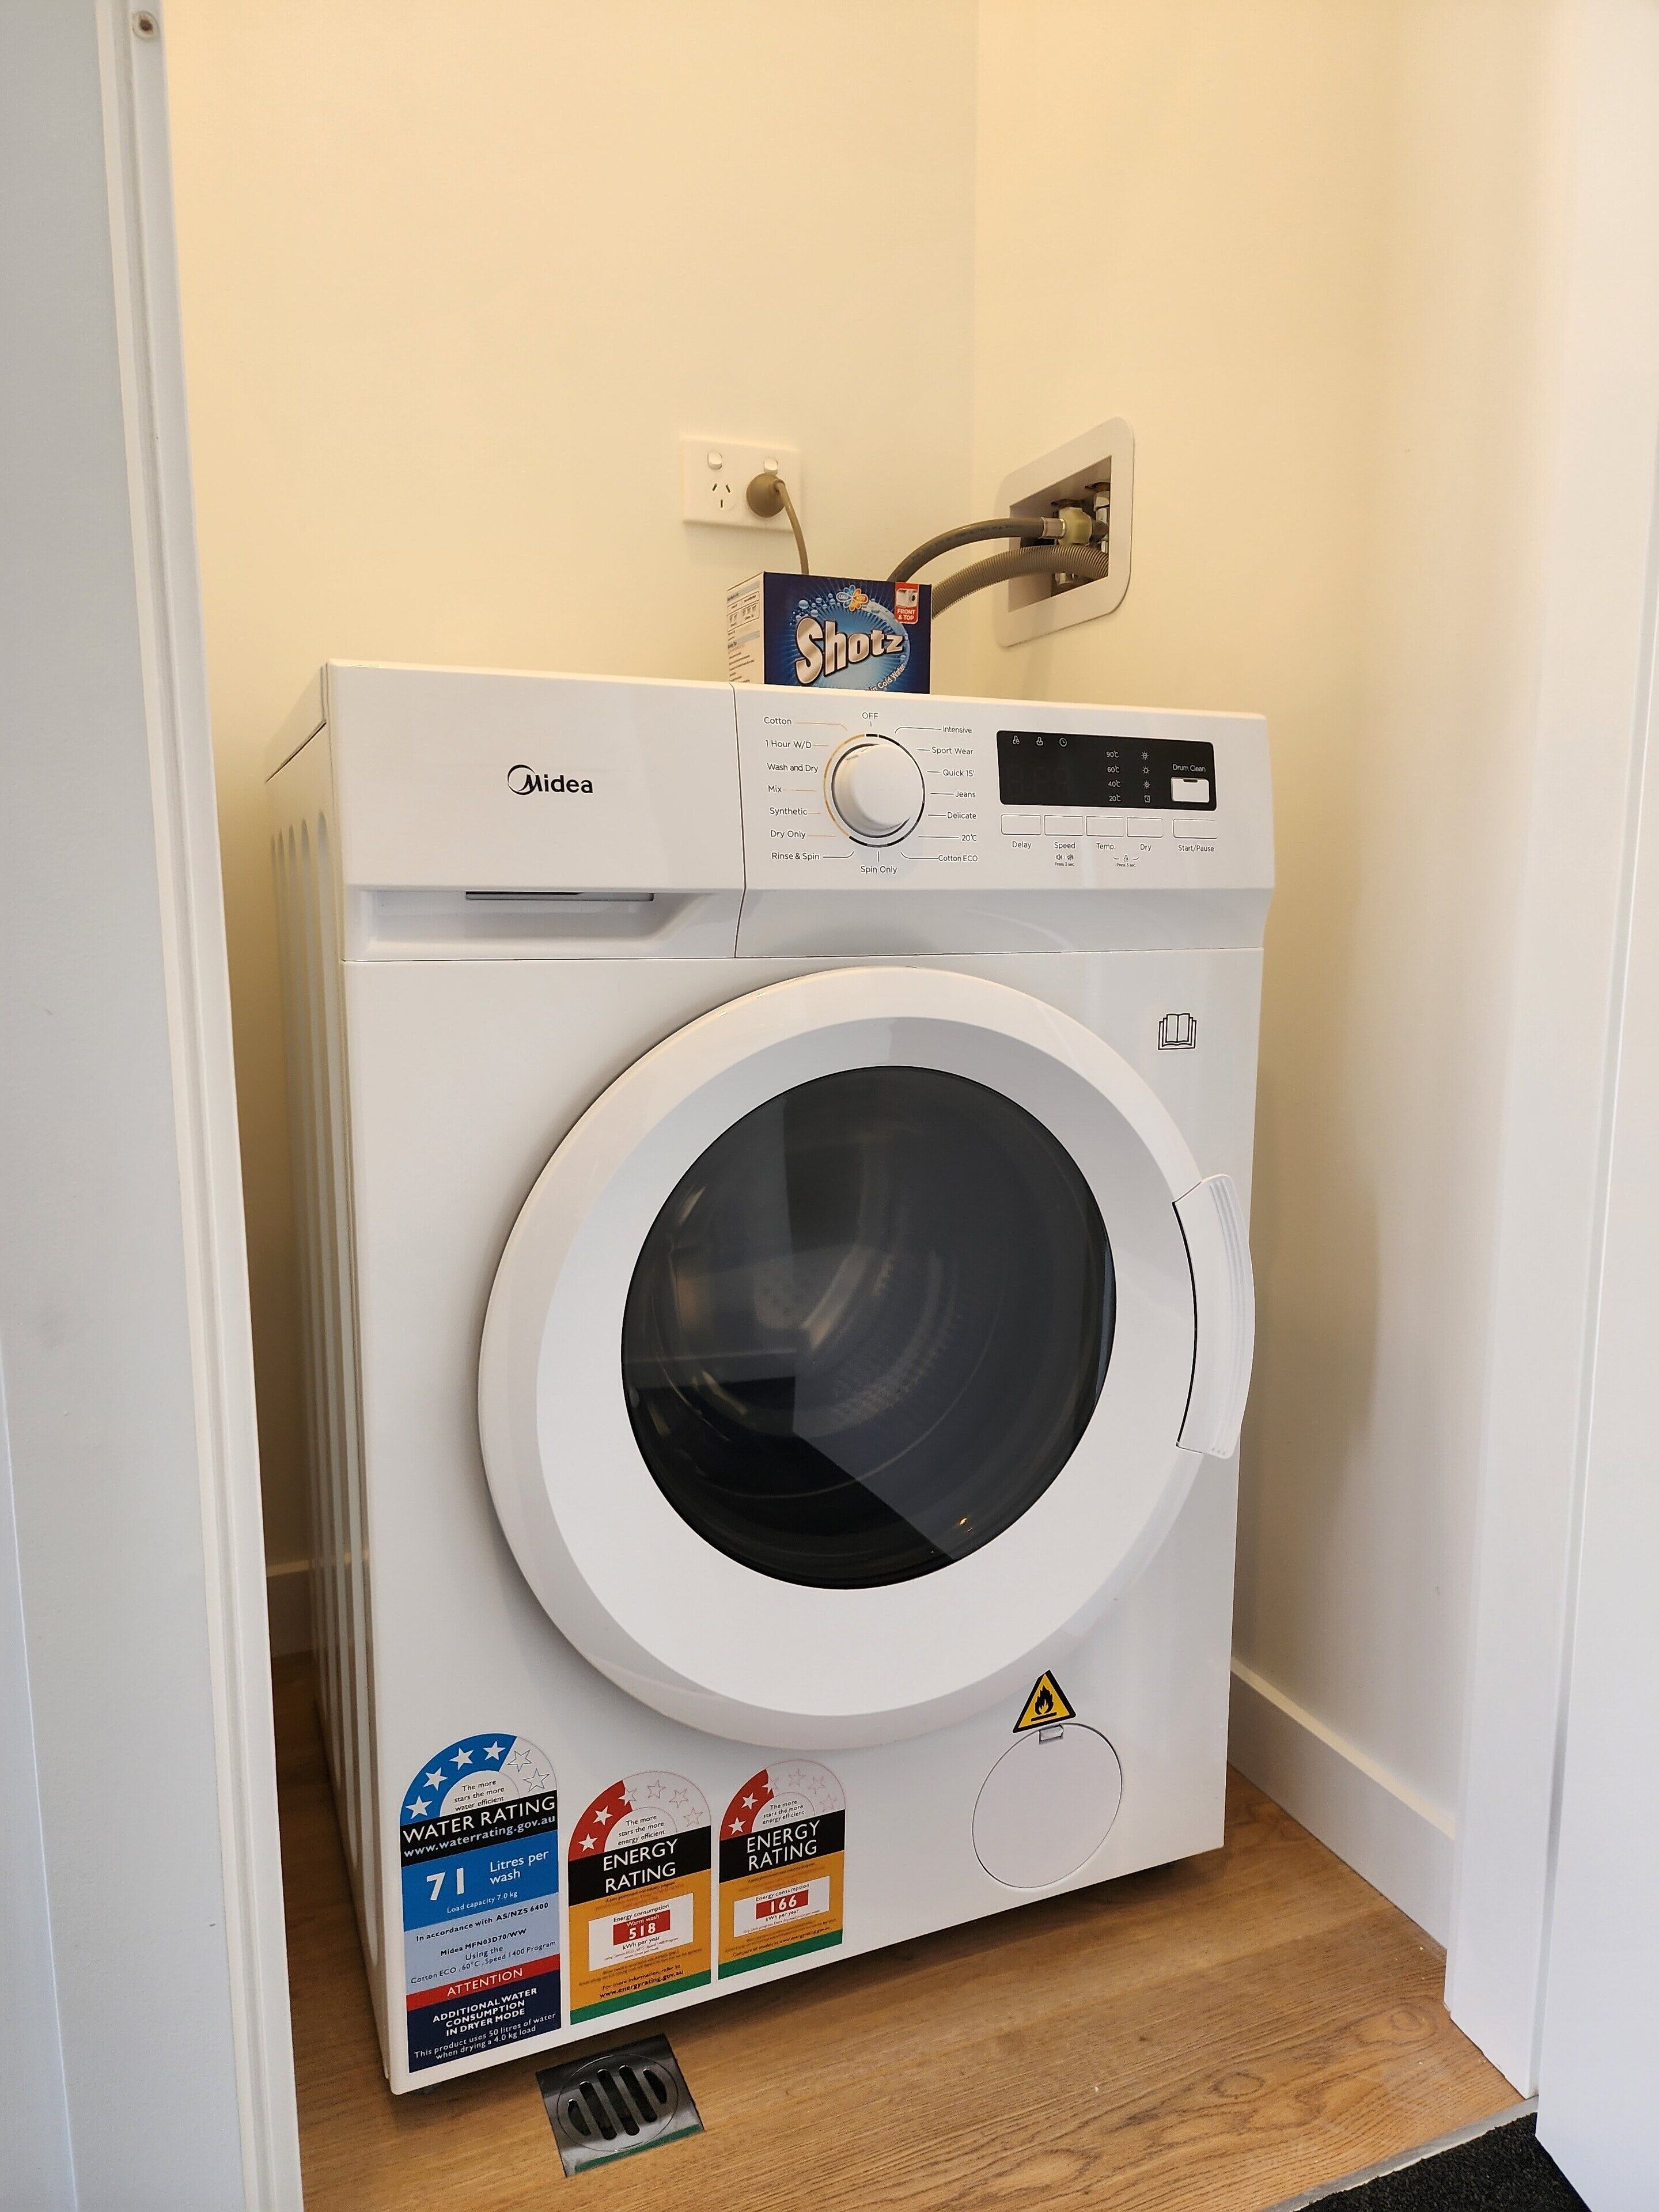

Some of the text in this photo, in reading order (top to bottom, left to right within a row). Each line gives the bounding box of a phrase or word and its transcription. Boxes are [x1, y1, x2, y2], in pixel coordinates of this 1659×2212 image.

[795, 617, 904, 685] Shotz
[877, 676, 893, 688] Cold
[890, 664, 906, 680] Water
[793, 741, 812, 749] W/D
[932, 747, 952, 755] Sport
[805, 765, 818, 774] Dry
[507, 764, 593, 796] Midea
[770, 808, 808, 817] Synthetic
[770, 830, 805, 839] Dry Only
[1012, 841, 1032, 850] Delay
[1054, 842, 1075, 851] Speed
[1140, 844, 1152, 852] Dry
[803, 853, 819, 861] Spin
[861, 866, 897, 874] Spin Only
[454, 1794, 471, 1803] stars
[486, 1787, 505, 1795] more
[455, 1796, 505, 1811] water efficient
[403, 1796, 555, 1843] WATER RATING
[640, 1815, 657, 1823] more
[647, 1822, 664, 1830] more
[763, 1810, 805, 1825] energy efficient
[404, 1816, 555, 1857] www.waterrating.gov.au
[618, 1830, 666, 1846] energy efficient
[747, 1820, 820, 1853] ENERGY
[490, 1850, 548, 1872] Litres per
[604, 1838, 678, 1872] ENERGY
[749, 1840, 817, 1871] RATING
[426, 1867, 464, 1901] 71
[490, 1870, 520, 1885] wash
[605, 1862, 676, 1893] RATING
[756, 1884, 809, 1902] Energy consumption
[447, 1904, 465, 1914] Load
[466, 1897, 495, 1910] capacity
[771, 1895, 797, 1913] 166
[426, 1923, 473, 1940] accordance
[475, 1917, 493, 1926] with
[495, 1908, 528, 1922] AS/NZS
[530, 1902, 548, 1912] 6400
[613, 1904, 669, 1923] Energy consumption
[465, 1929, 527, 1949] MFN03D70/WW
[629, 1922, 656, 1940] 518
[649, 1936, 661, 1945] year
[411, 1972, 437, 1983] Cotton
[439, 1967, 456, 1977] ECO
[485, 1954, 506, 1965] Speed
[509, 1948, 525, 1959] 1400
[527, 1941, 556, 1953] Program
[465, 1946, 503, 1961] Using the
[447, 1968, 523, 1997] ATTENTION
[433, 1988, 537, 2023] ADDITIONAL WATER
[446, 1999, 525, 2028] CONSUMPTION
[446, 2008, 525, 2037] IN DRYER MODE
[414, 2013, 556, 2058] This product uses 50 litres of water
[436, 2050, 458, 2060] when
[460, 2041, 486, 2053] drying
[494, 2034, 506, 2043] 4.0
[508, 2031, 517, 2040] kg
[519, 2025, 536, 2036] load
